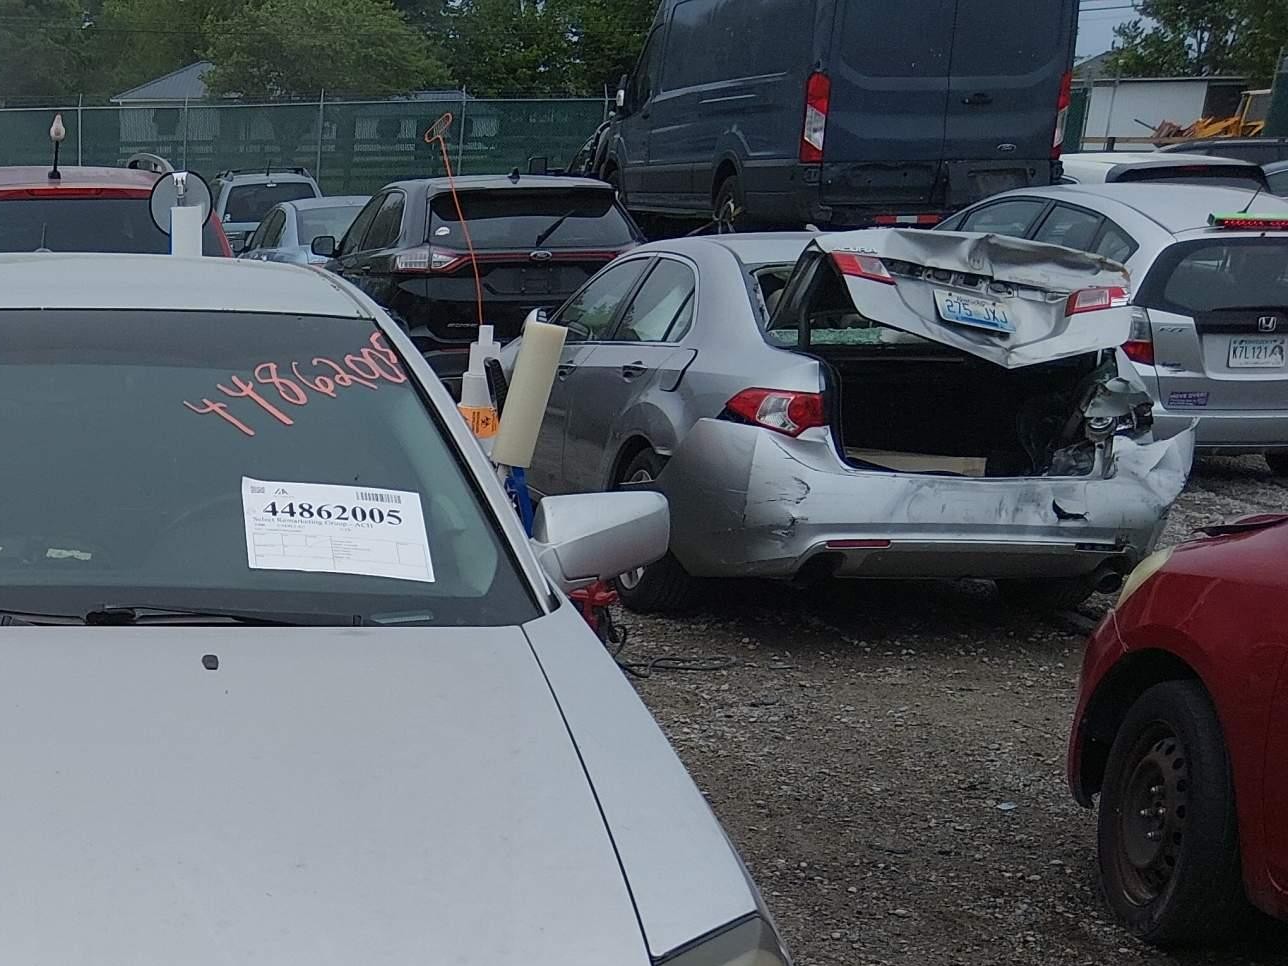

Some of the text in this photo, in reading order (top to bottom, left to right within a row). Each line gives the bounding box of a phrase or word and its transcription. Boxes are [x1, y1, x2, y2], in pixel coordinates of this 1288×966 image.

[945, 298, 973, 317] 275
[983, 307, 1009, 324] JXJ
[262, 501, 403, 526] 44862005
